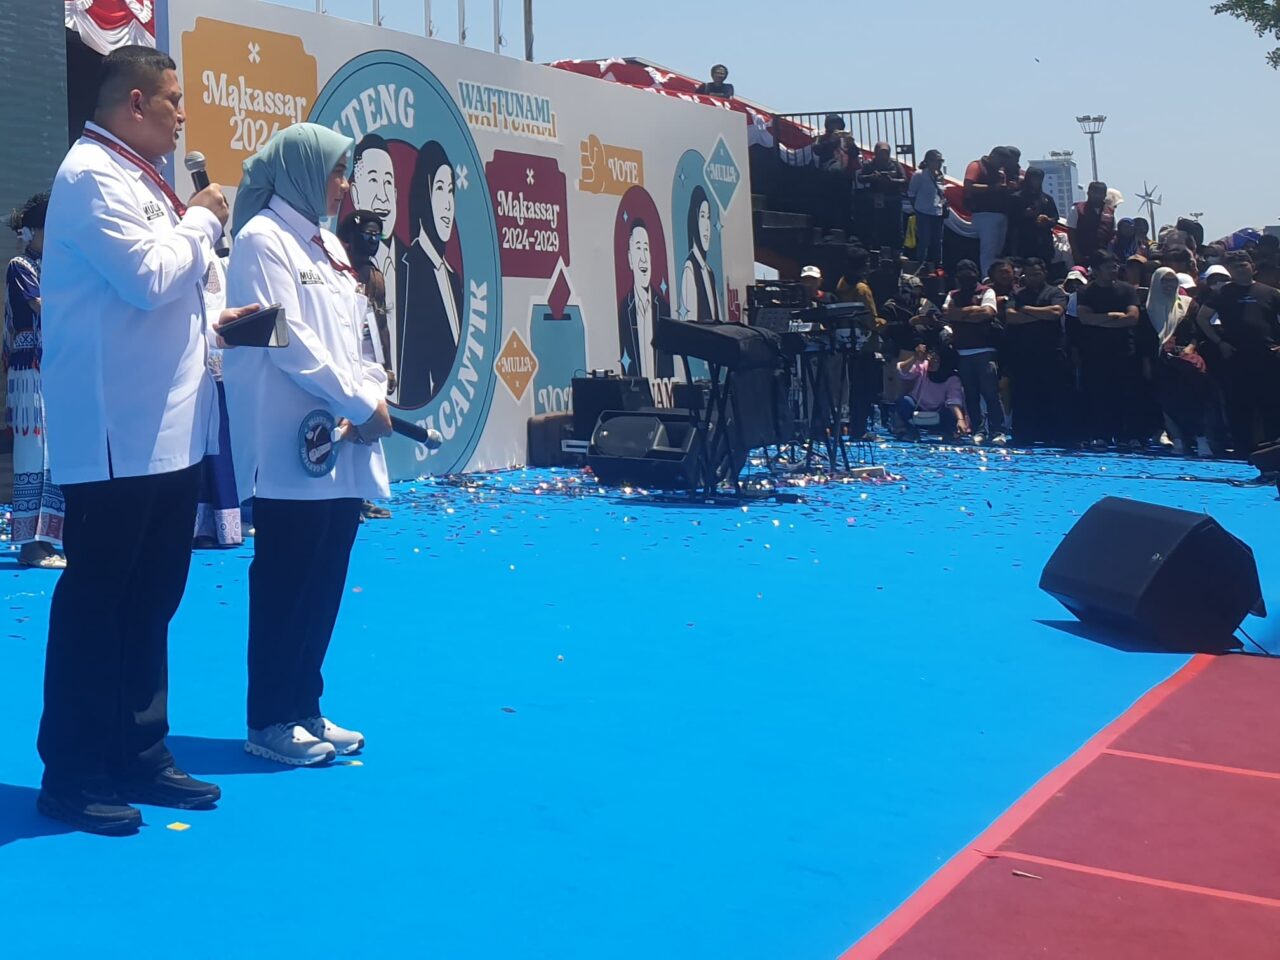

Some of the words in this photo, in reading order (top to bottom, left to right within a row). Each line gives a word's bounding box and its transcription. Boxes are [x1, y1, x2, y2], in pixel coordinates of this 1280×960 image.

[202, 70, 307, 124] Makassar
[458, 81, 551, 124] WATTUNAMI
[608, 158, 639, 184] VOTE
[497, 190, 560, 229] Makassar
[502, 227, 560, 253] 2024-2029
[538, 385, 573, 414] VOT
